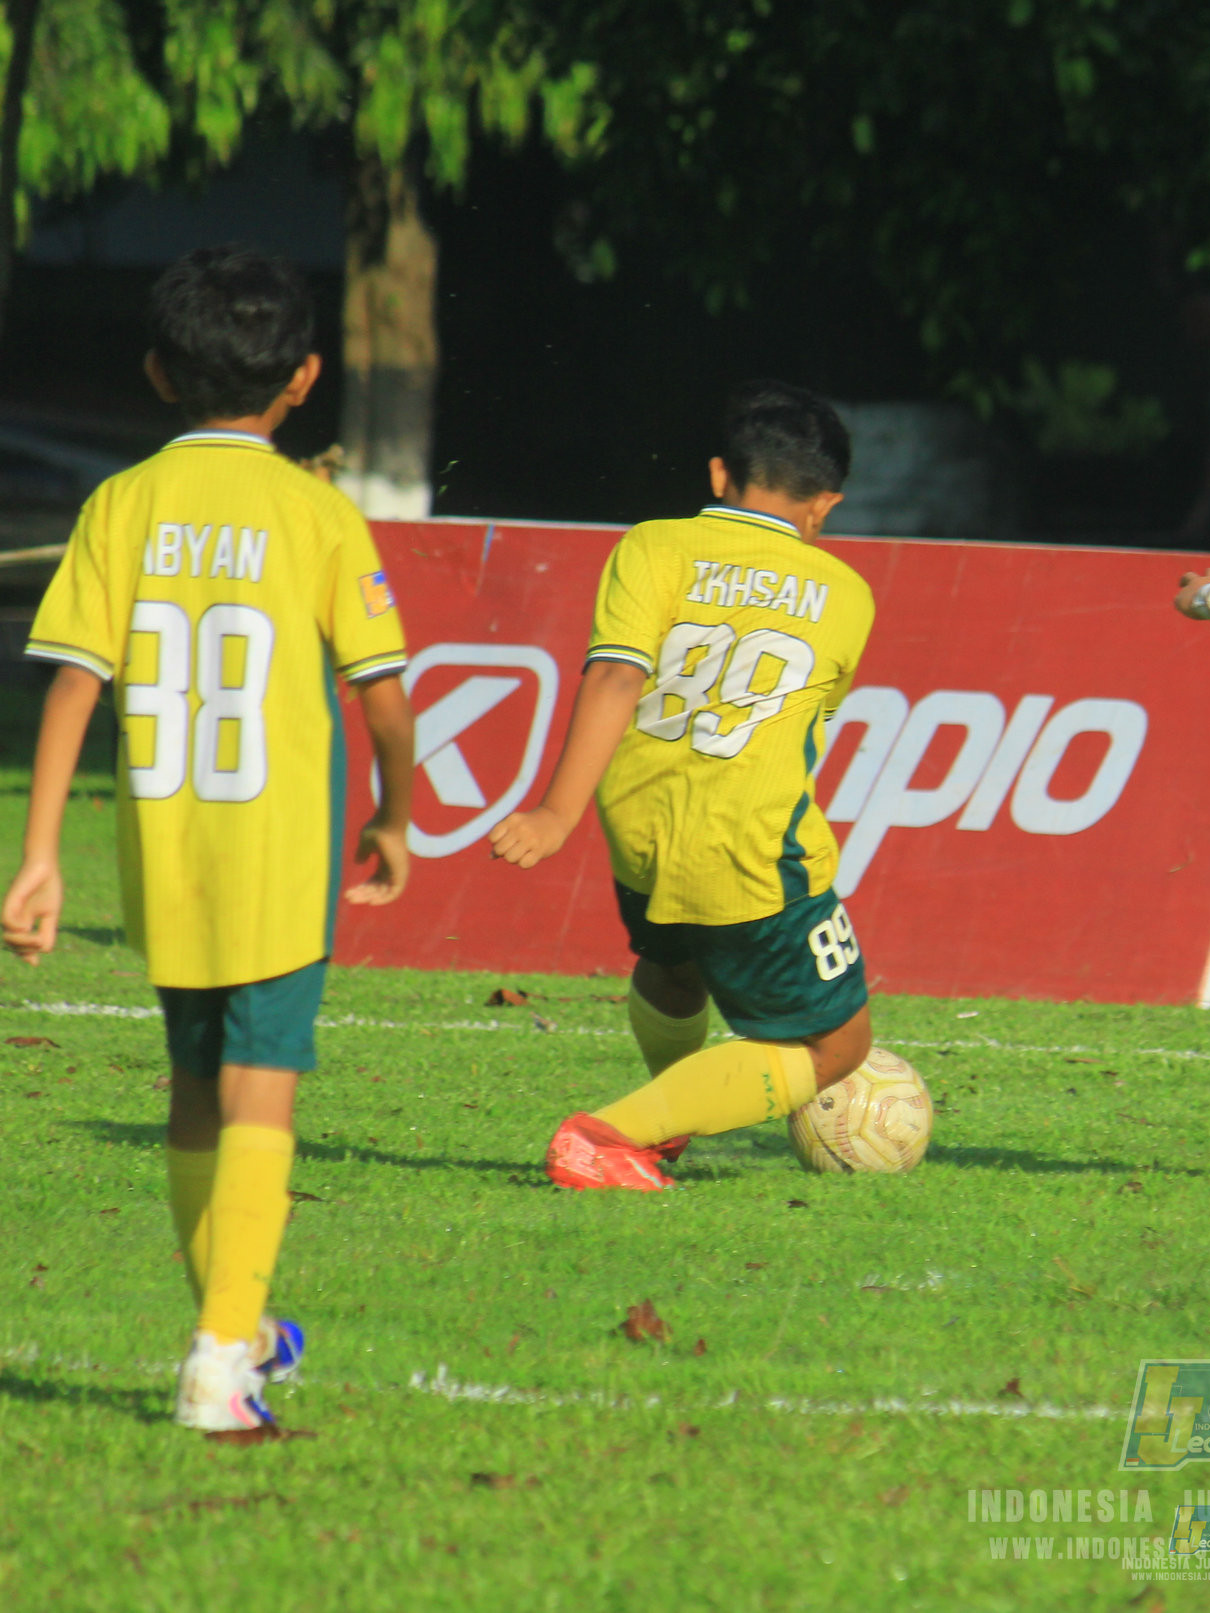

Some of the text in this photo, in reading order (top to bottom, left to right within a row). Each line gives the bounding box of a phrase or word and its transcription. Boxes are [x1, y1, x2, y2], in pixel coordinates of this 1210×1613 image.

[686, 560, 829, 623] IKHSAN
[636, 621, 815, 760] 89
[808, 902, 860, 982] 89
